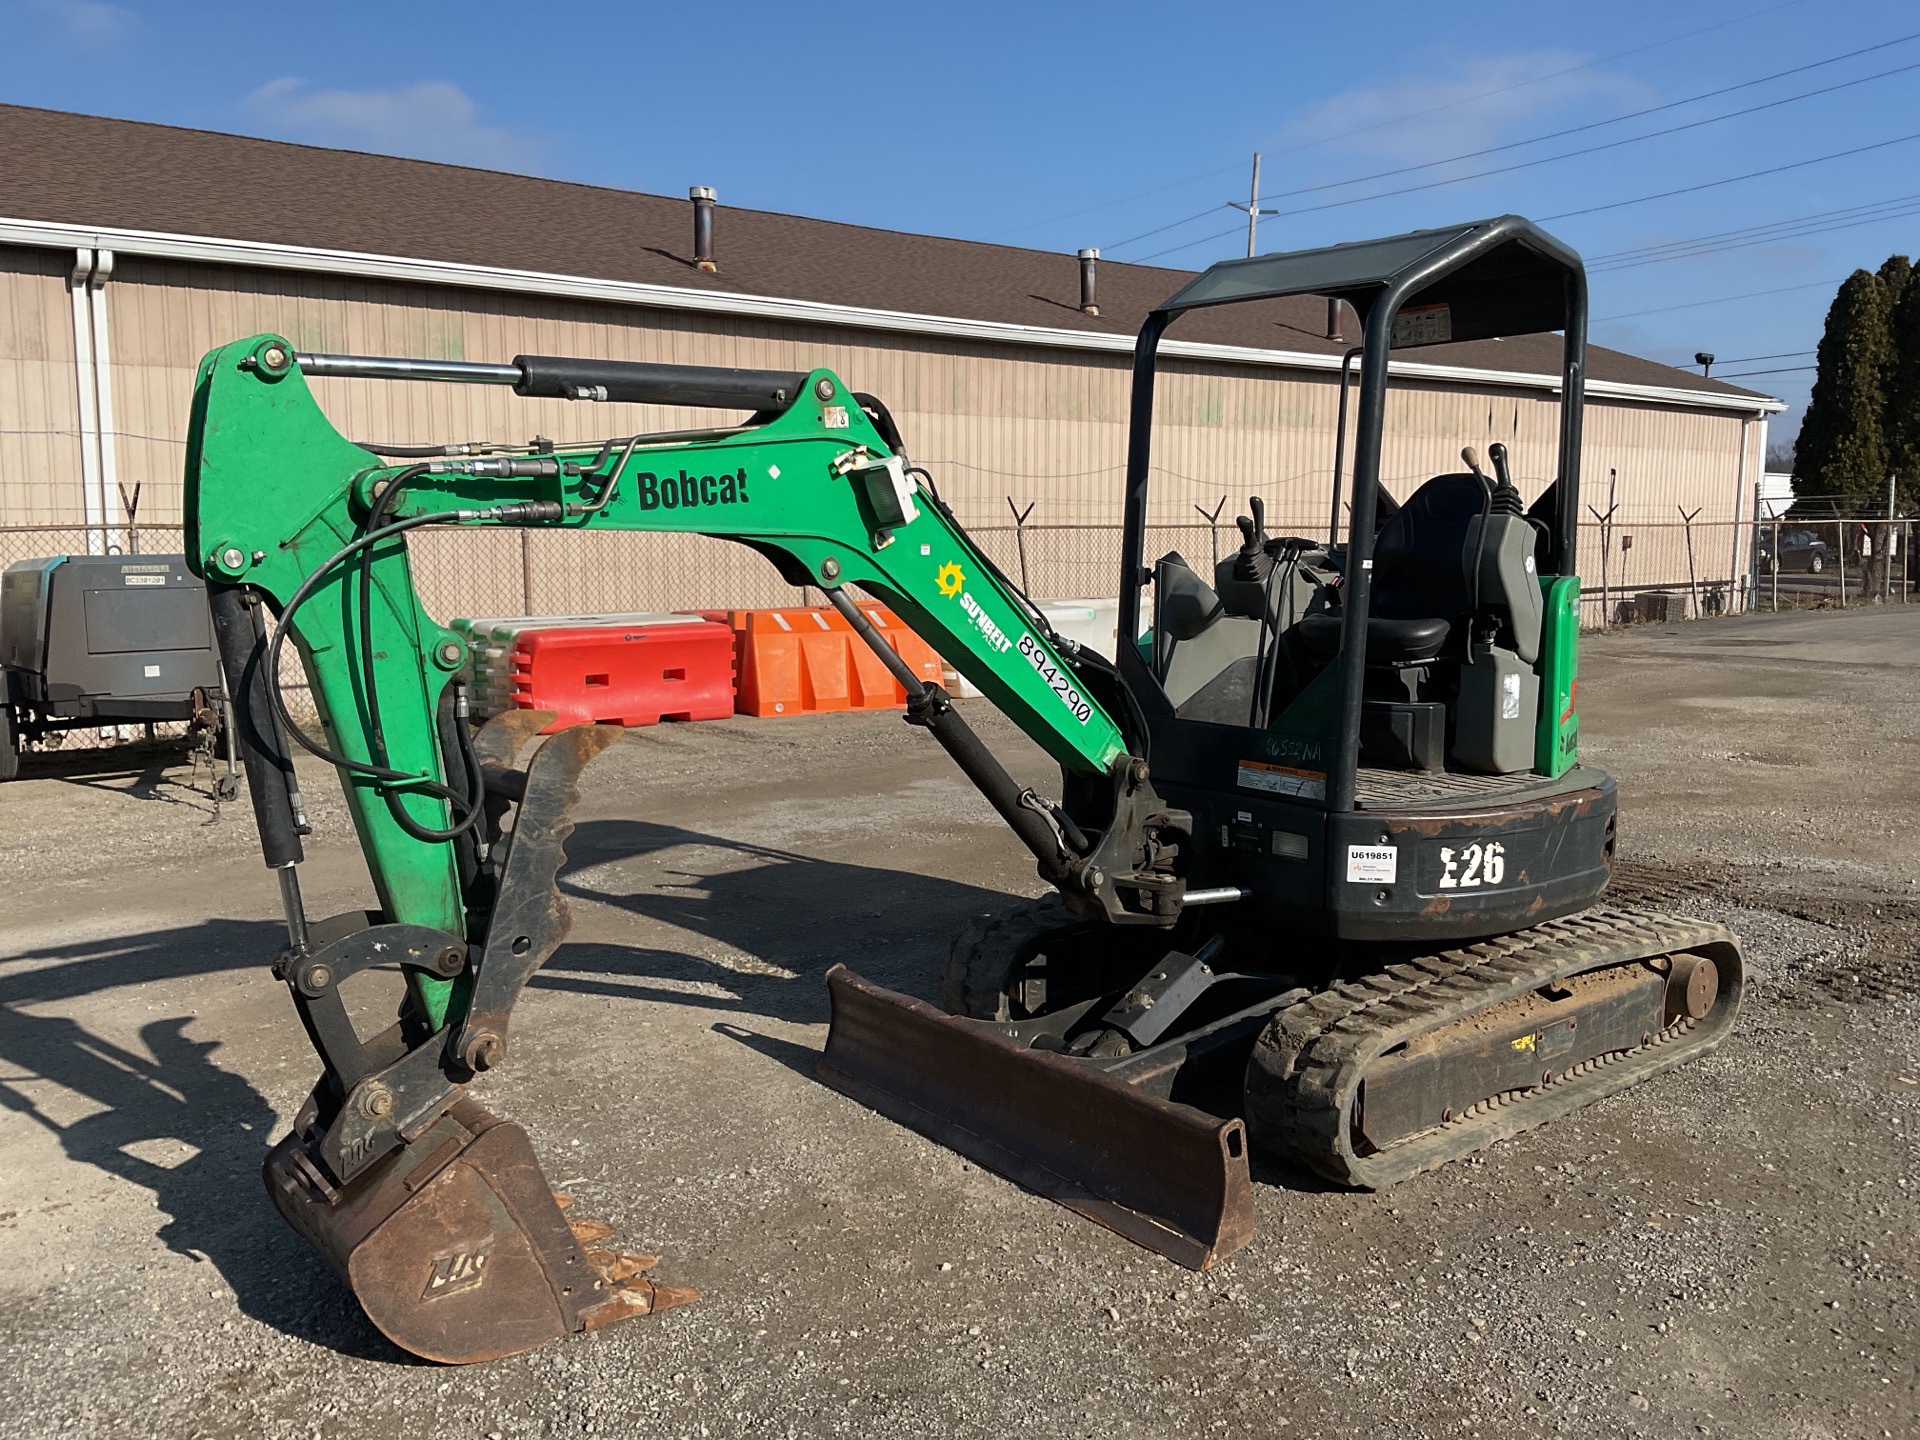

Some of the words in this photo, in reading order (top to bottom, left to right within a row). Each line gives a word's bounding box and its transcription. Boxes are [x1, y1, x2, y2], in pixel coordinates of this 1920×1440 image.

[637, 468, 749, 511] Bobcat
[959, 592, 1013, 654] SUNBELT
[1018, 635, 1093, 722] 894290
[1351, 851, 1393, 860] U619851
[1439, 841, 1505, 889] E26
